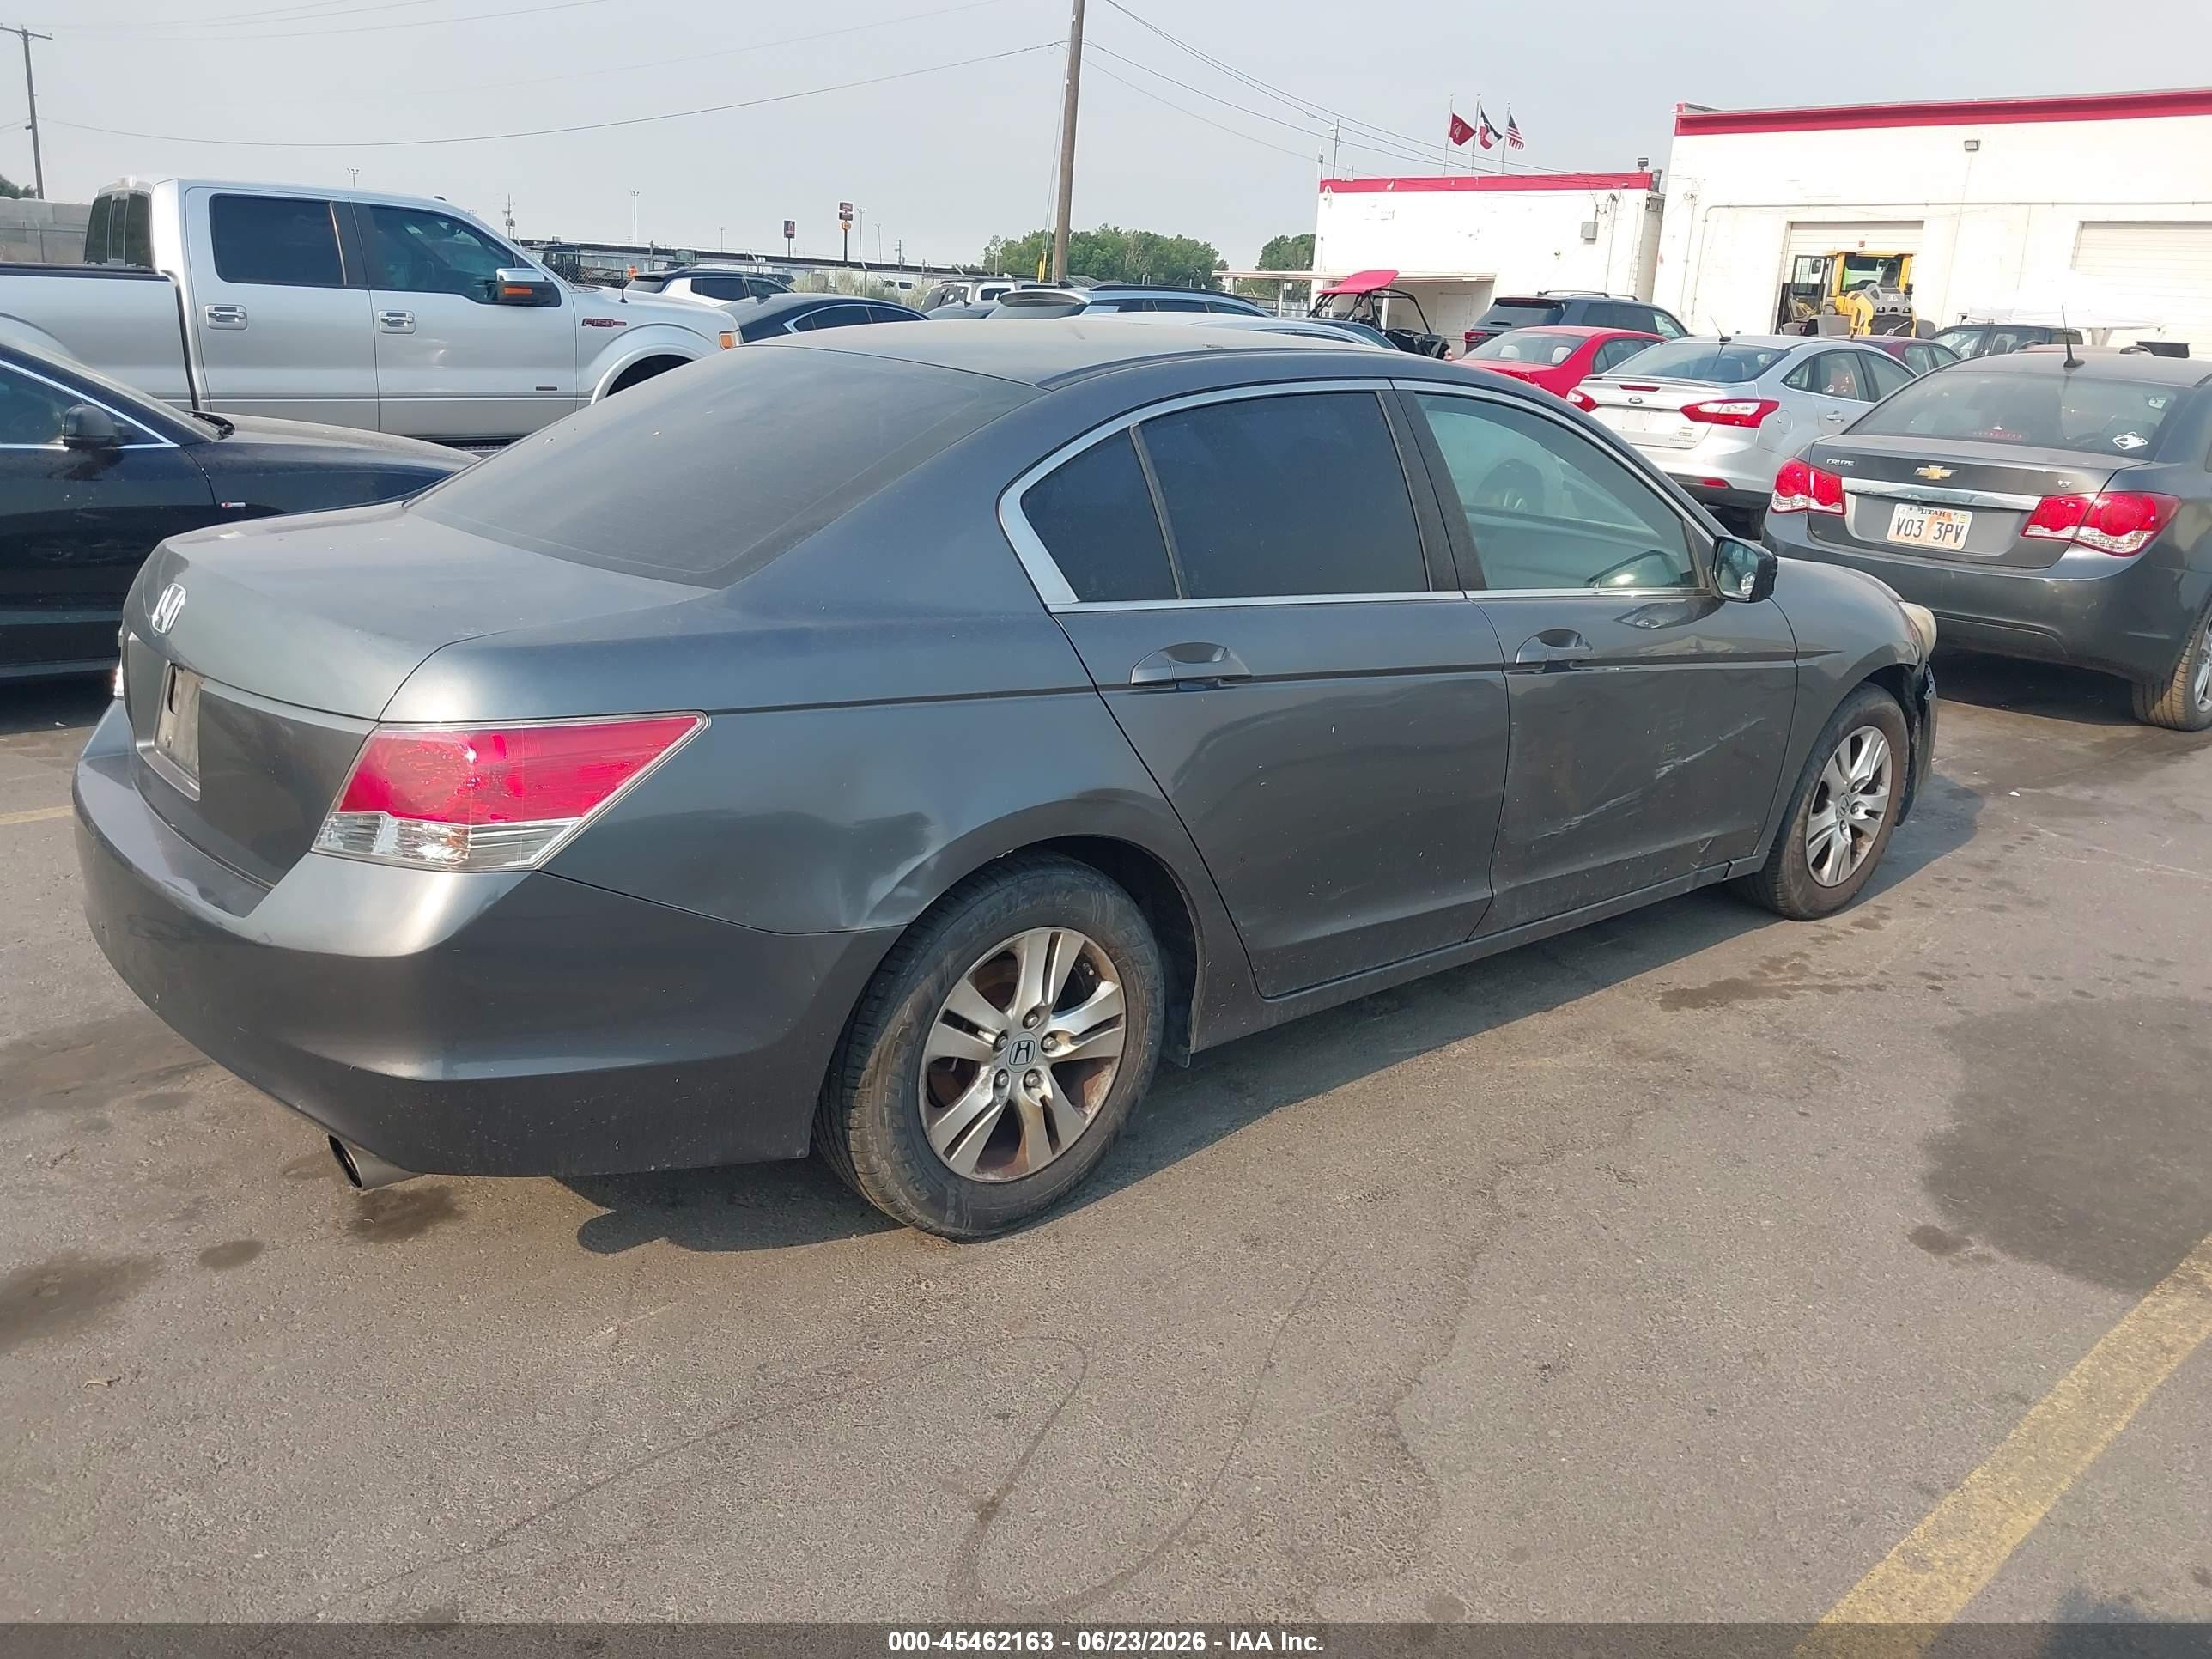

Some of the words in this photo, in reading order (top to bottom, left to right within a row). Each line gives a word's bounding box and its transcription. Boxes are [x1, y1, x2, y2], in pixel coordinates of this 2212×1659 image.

[1920, 508, 1947, 518] UTAH
[1895, 517, 1925, 538] V03
[1932, 521, 1965, 544] 3PV
